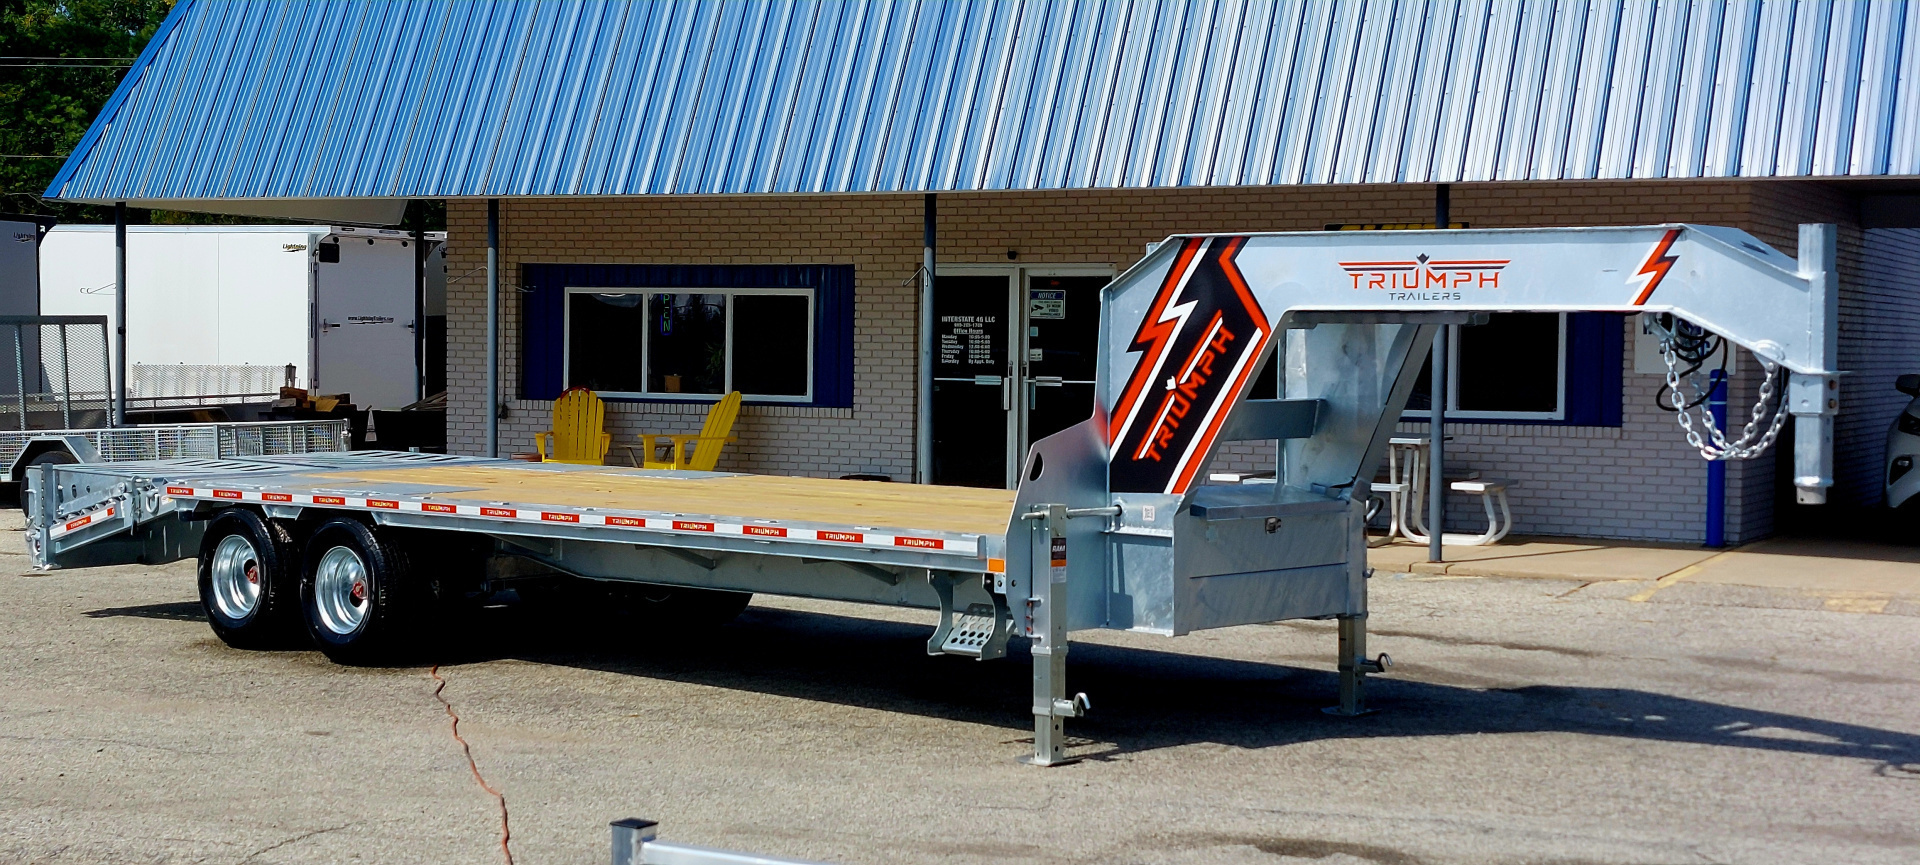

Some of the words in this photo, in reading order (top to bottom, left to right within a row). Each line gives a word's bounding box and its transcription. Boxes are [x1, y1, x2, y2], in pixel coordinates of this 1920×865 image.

[1348, 268, 1500, 289] TRIUMPH
[1389, 292, 1461, 300] TRAILERS
[663, 293, 671, 331] PEN
[1144, 325, 1235, 462] TRIUMPH
[903, 539, 935, 547] TRIUMPH
